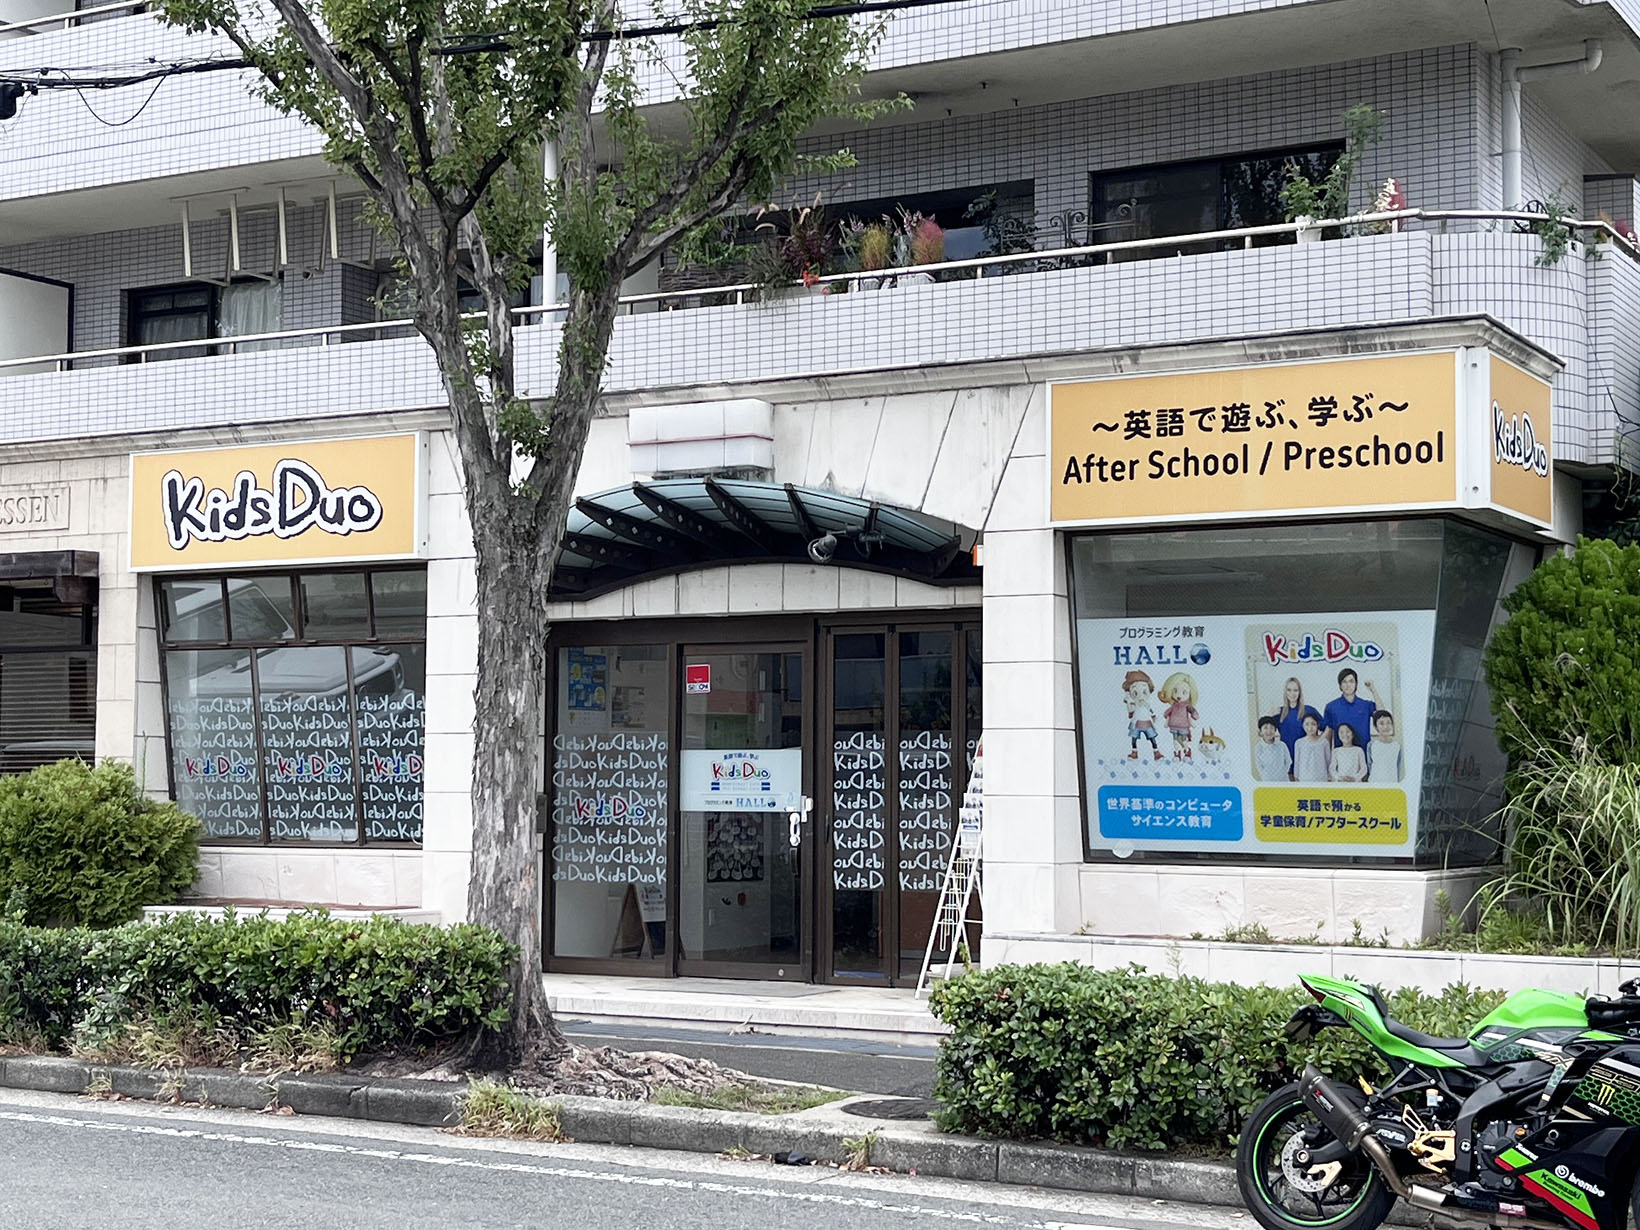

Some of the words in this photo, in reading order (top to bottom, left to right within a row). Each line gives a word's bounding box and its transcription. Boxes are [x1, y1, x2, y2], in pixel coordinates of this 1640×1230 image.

[1493, 402, 1547, 474] KidsDuo
[1063, 453, 1140, 484] After
[1148, 443, 1249, 479] School
[1284, 431, 1444, 471] Preschool
[0, 495, 60, 525] SSEN
[165, 463, 379, 546] KidsDuo
[1119, 625, 1205, 638] プログラミング教育
[1264, 630, 1381, 664] KidsDuo
[374, 755, 424, 776] KidsD
[712, 761, 770, 780] KidsDuo
[1106, 797, 1233, 812] 世界基準のコンピュータ
[1297, 799, 1361, 812] 英語で預かる
[1131, 814, 1213, 828] サイエンス教育
[1260, 815, 1402, 830] 学童保育/アフタースクール
